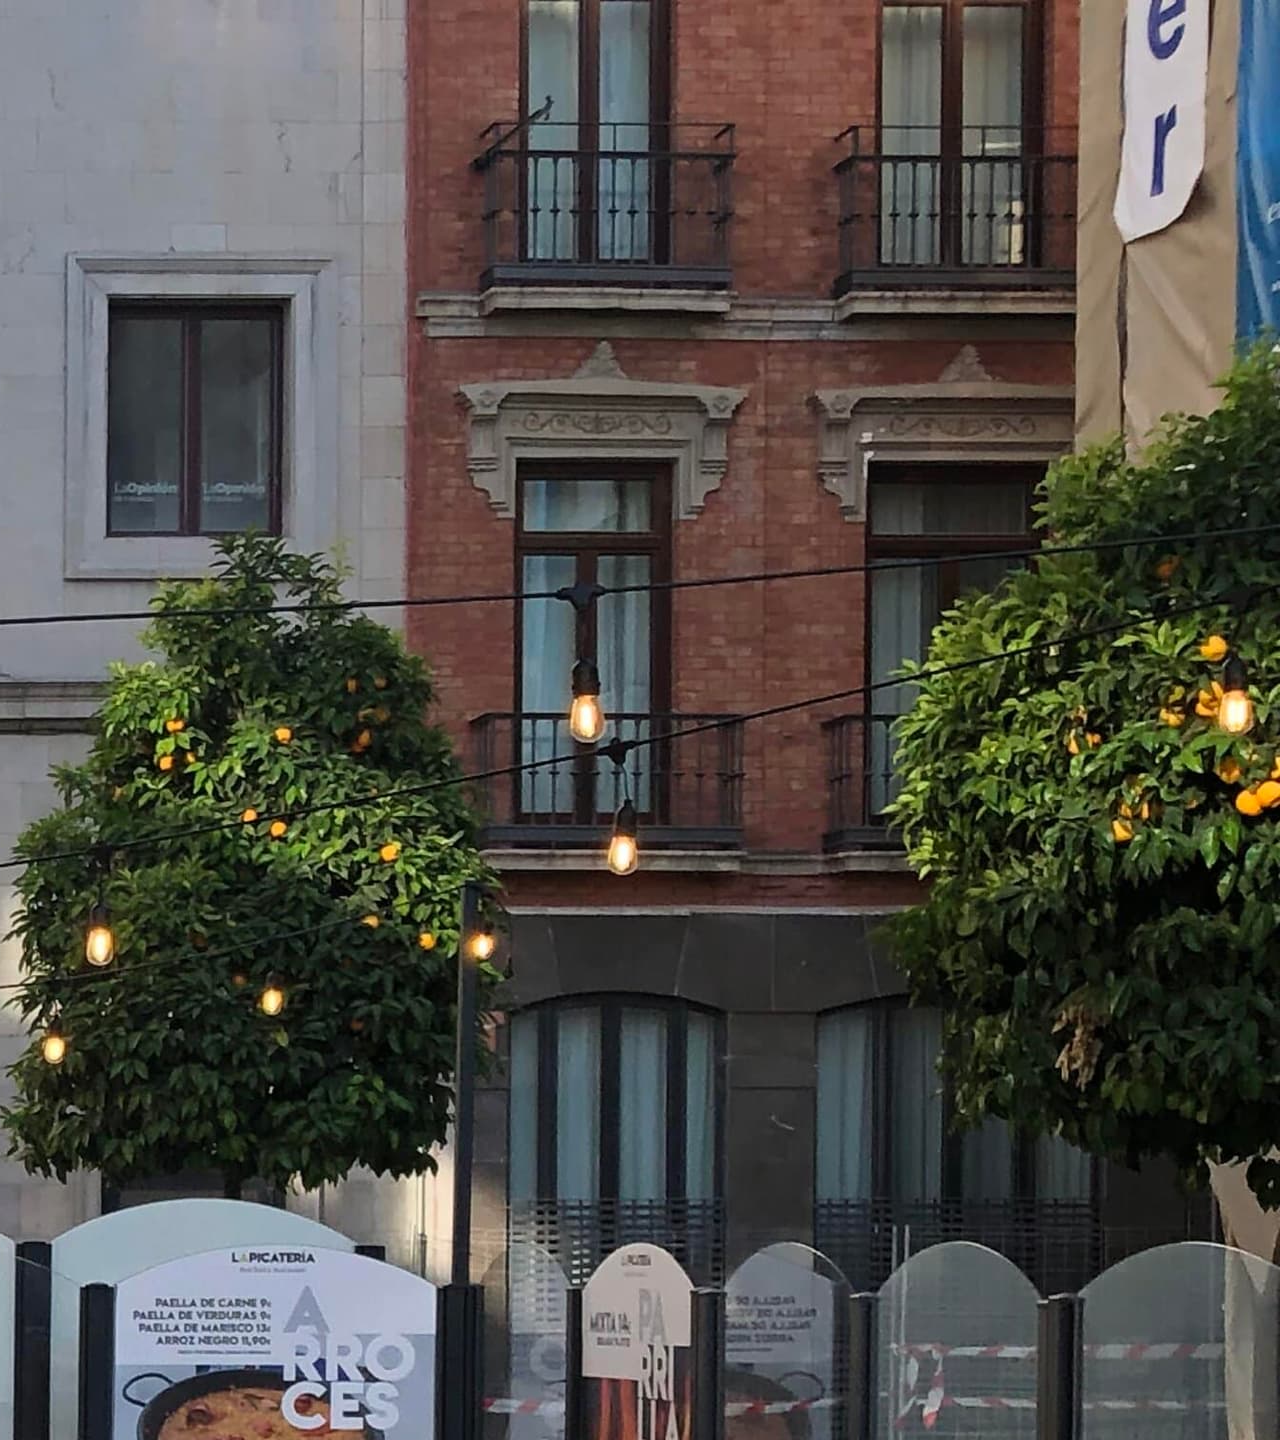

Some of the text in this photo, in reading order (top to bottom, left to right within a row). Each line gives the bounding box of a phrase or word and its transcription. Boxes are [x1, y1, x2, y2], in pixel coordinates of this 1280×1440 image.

[133, 1310, 175, 1320] PAELLA
[178, 1310, 194, 1320] DE
[195, 1310, 257, 1320] VERDURAS
[155, 1298, 197, 1308] PAELLA
[200, 1298, 216, 1308] DE
[218, 1298, 257, 1308] CARNE
[283, 1285, 330, 1333] A
[138, 1323, 180, 1333] PAELLA
[184, 1323, 199, 1333] DE
[201, 1323, 254, 1333] MARISCO
[155, 1336, 195, 1346] ARROZ
[197, 1336, 239, 1346] NEGRO
[283, 1333, 416, 1382] RRO
[638, 1344, 674, 1401] RRI
[281, 1380, 401, 1431] CES
